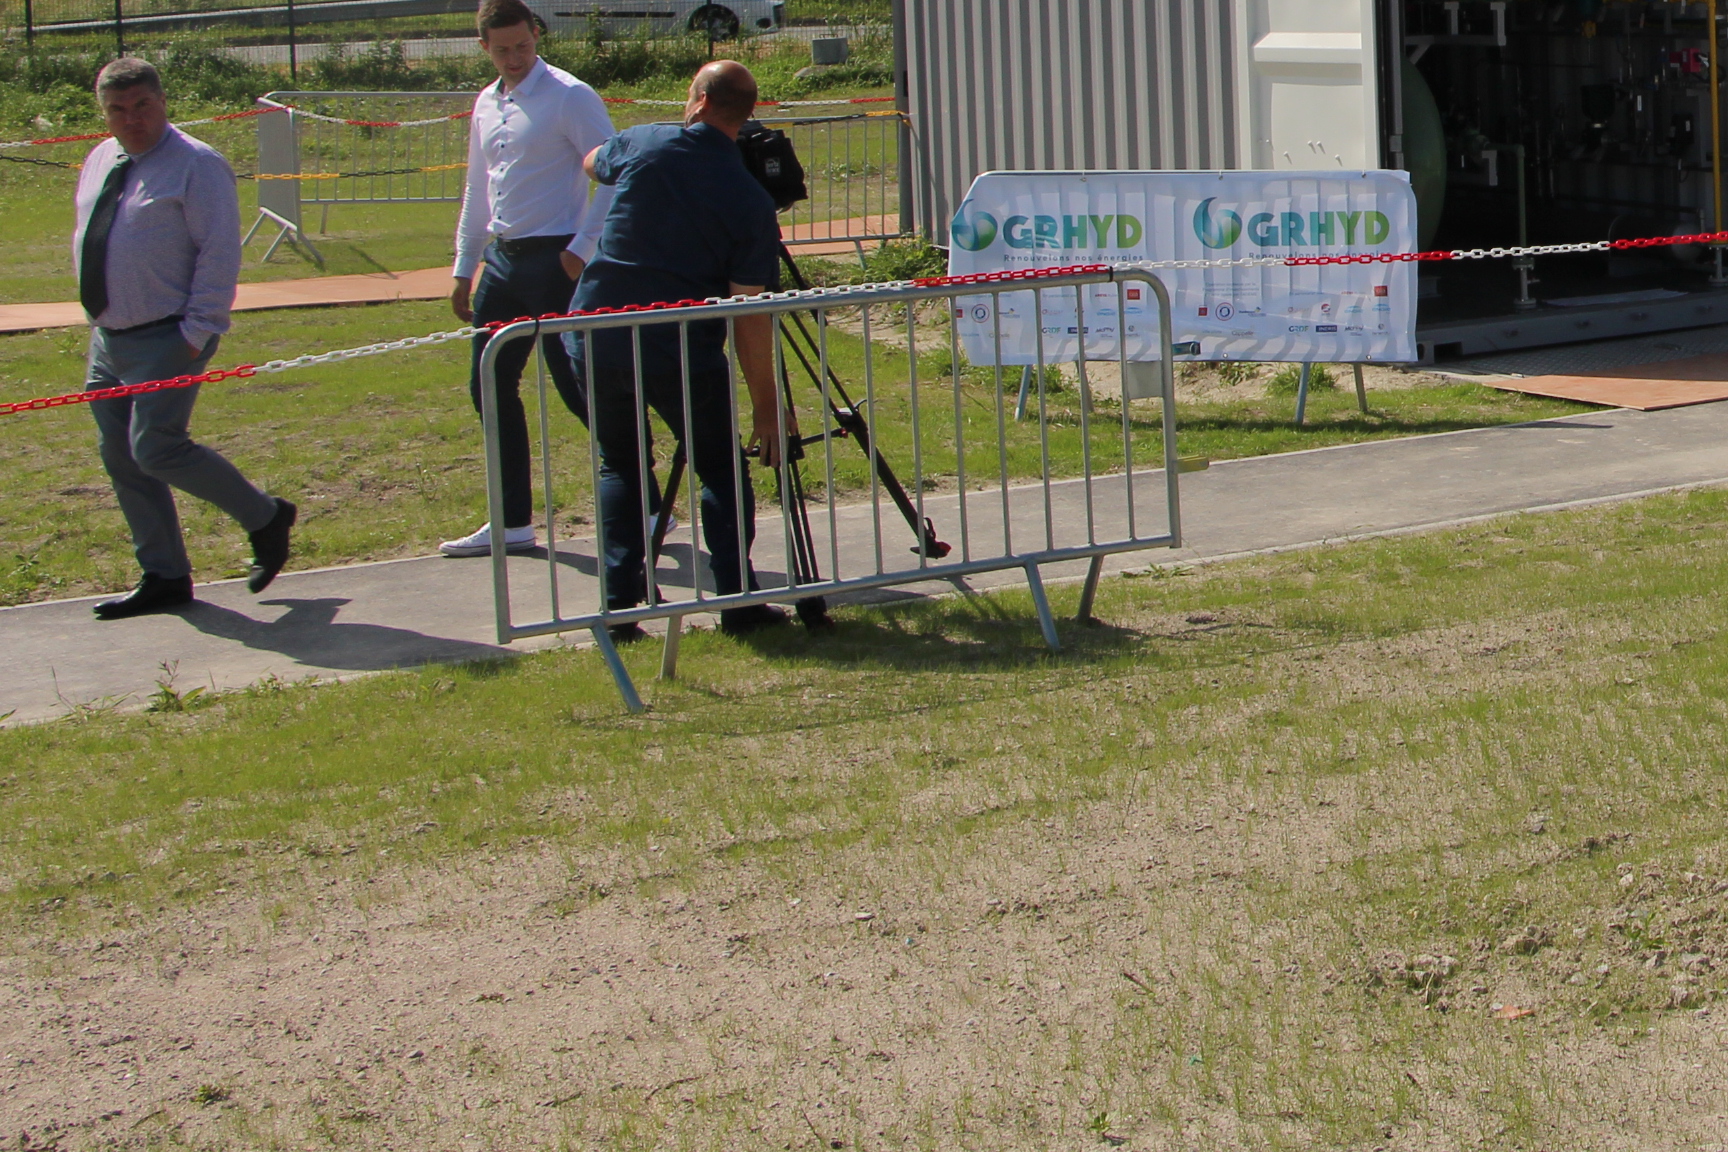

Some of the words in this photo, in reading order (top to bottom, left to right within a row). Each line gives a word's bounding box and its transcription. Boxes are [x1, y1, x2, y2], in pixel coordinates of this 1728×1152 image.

[1002, 214, 1143, 249] GRHYD
[1247, 210, 1390, 247] GRHYD
[1003, 254, 1070, 263] Renouvelons
[1097, 253, 1144, 263] énergies
